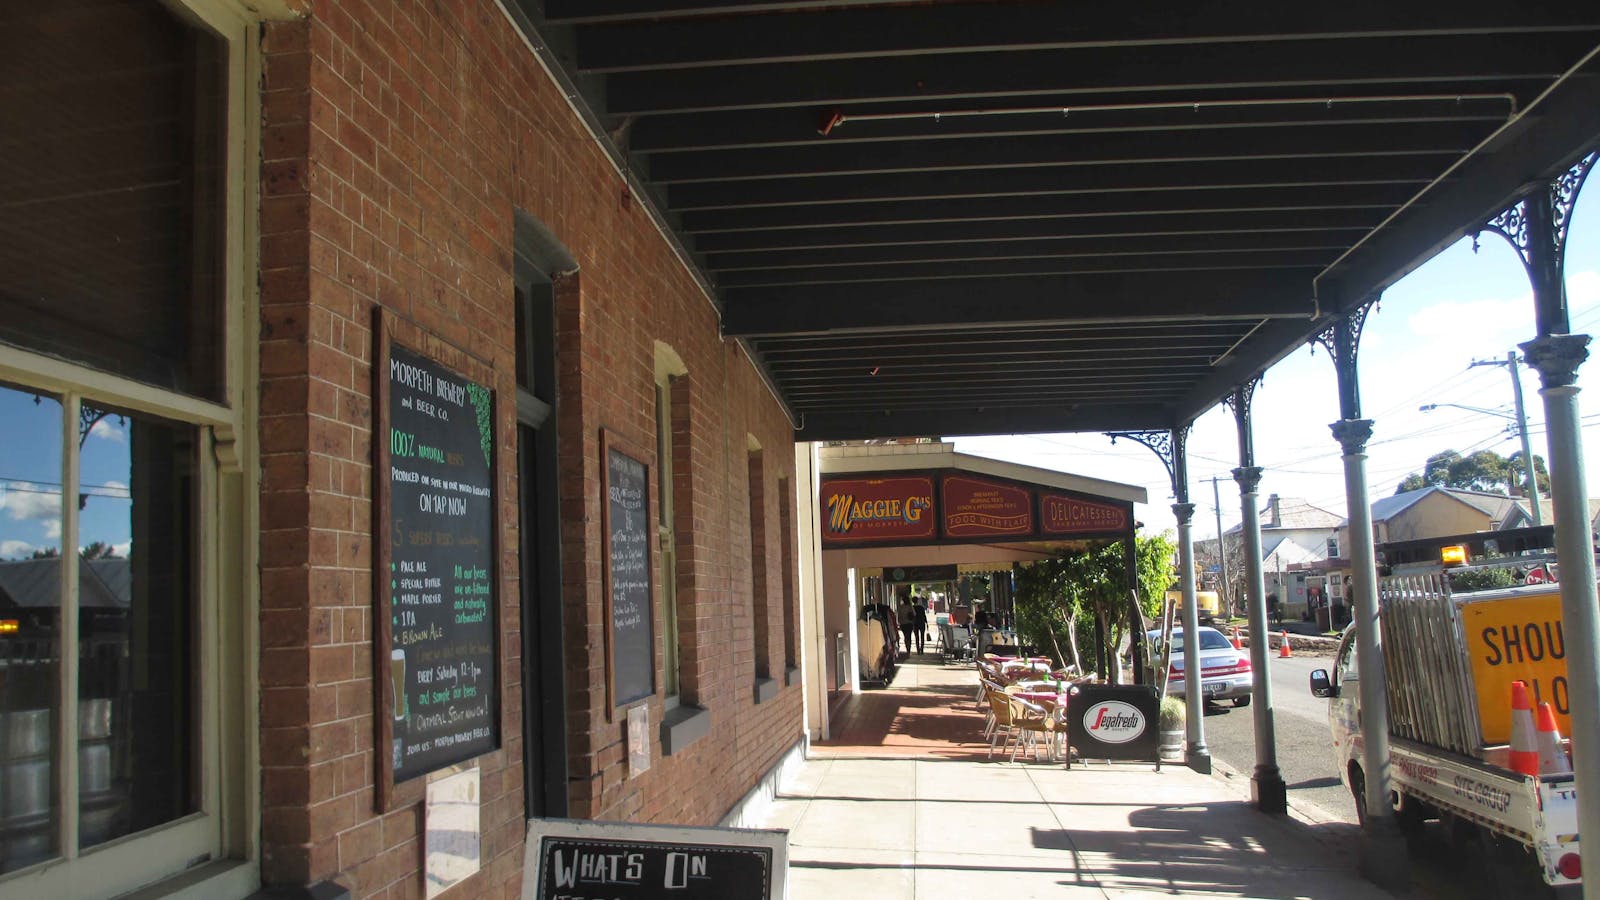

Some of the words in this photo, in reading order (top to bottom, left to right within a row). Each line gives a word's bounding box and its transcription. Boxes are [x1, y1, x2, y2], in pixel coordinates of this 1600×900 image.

[390, 358, 433, 395] MORPETH
[436, 377, 466, 408] BREWERY
[401, 395, 413, 410] and
[416, 398, 436, 418] BEER
[390, 427, 416, 457] 100%
[418, 444, 446, 464] NATURAL
[391, 466, 420, 483] PRODUCED
[420, 475, 430, 486] ON
[430, 477, 442, 488] SITE
[419, 493, 432, 513] ON
[432, 494, 447, 514] TAP
[448, 497, 467, 516] NOW
[829, 494, 902, 531] MAGGIE
[1051, 502, 1119, 521] DELICATESSEN
[950, 515, 976, 525] FOOD
[979, 516, 1002, 528] WITH
[400, 560, 415, 573] PALE
[416, 561, 427, 573] ALE
[454, 563, 463, 579] All
[400, 578, 423, 590] SPECIAL
[401, 593, 420, 605] MAPLE
[401, 610, 416, 627] IPA
[402, 629, 428, 645] BROWN
[428, 622, 444, 641] ALE
[1482, 620, 1565, 666] SHOU
[417, 668, 434, 684] EVERY
[418, 690, 430, 705] and
[1091, 708, 1139, 731] Segafredo
[1454, 775, 1475, 800] SITE
[1475, 782, 1512, 815] GROUP
[554, 848, 644, 889] WHAT'S
